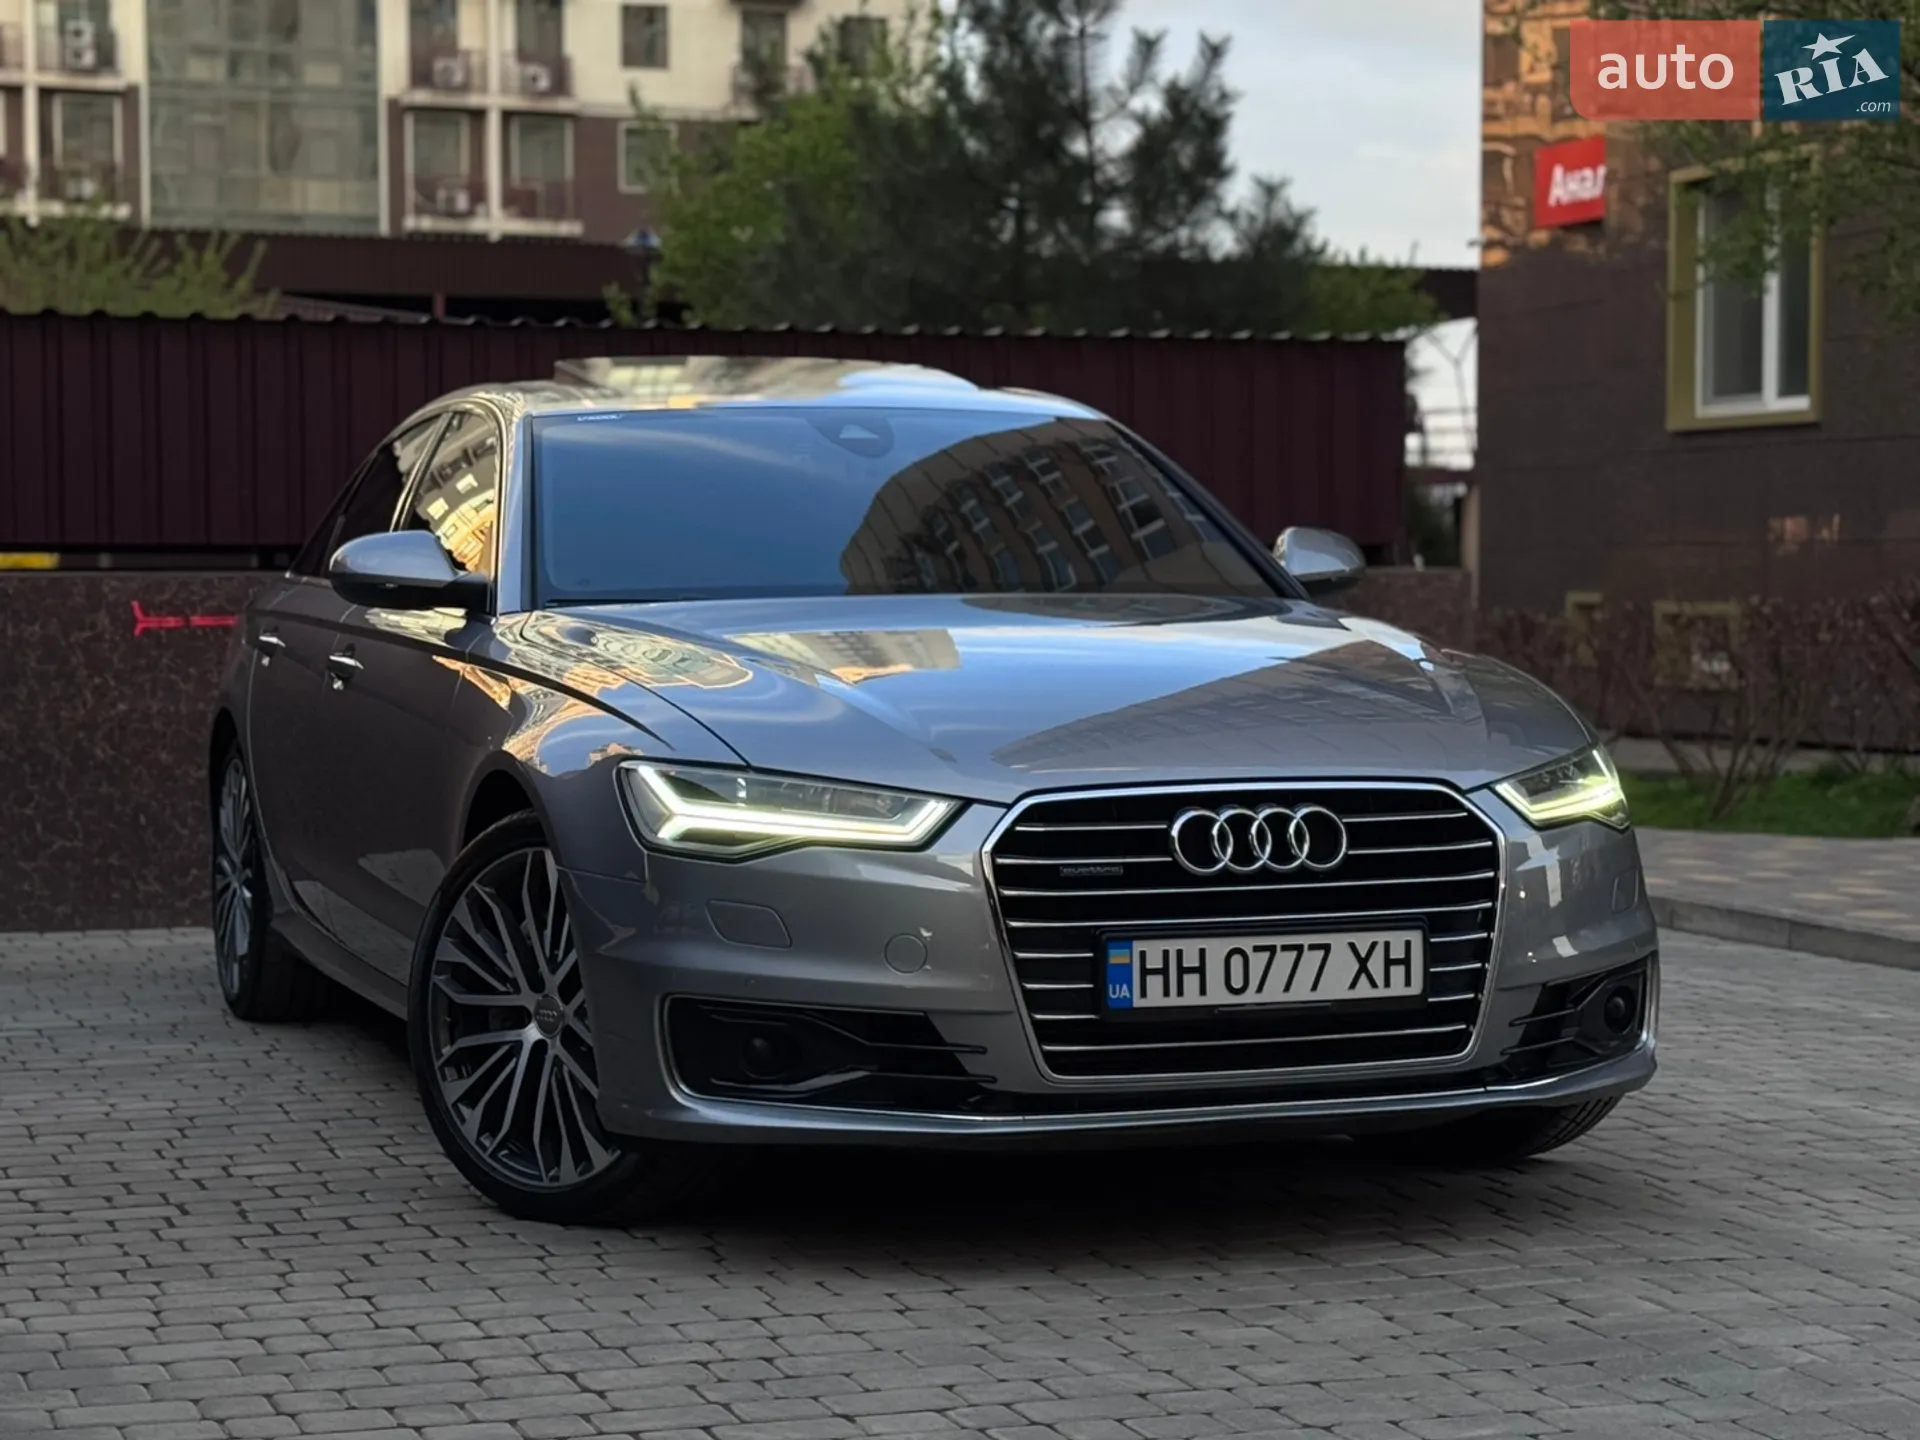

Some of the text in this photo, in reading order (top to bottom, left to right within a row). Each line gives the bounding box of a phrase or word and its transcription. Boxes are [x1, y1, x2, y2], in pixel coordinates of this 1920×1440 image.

[1139, 939, 1412, 999] HH 0777 XH
[1109, 983, 1131, 999] UA
